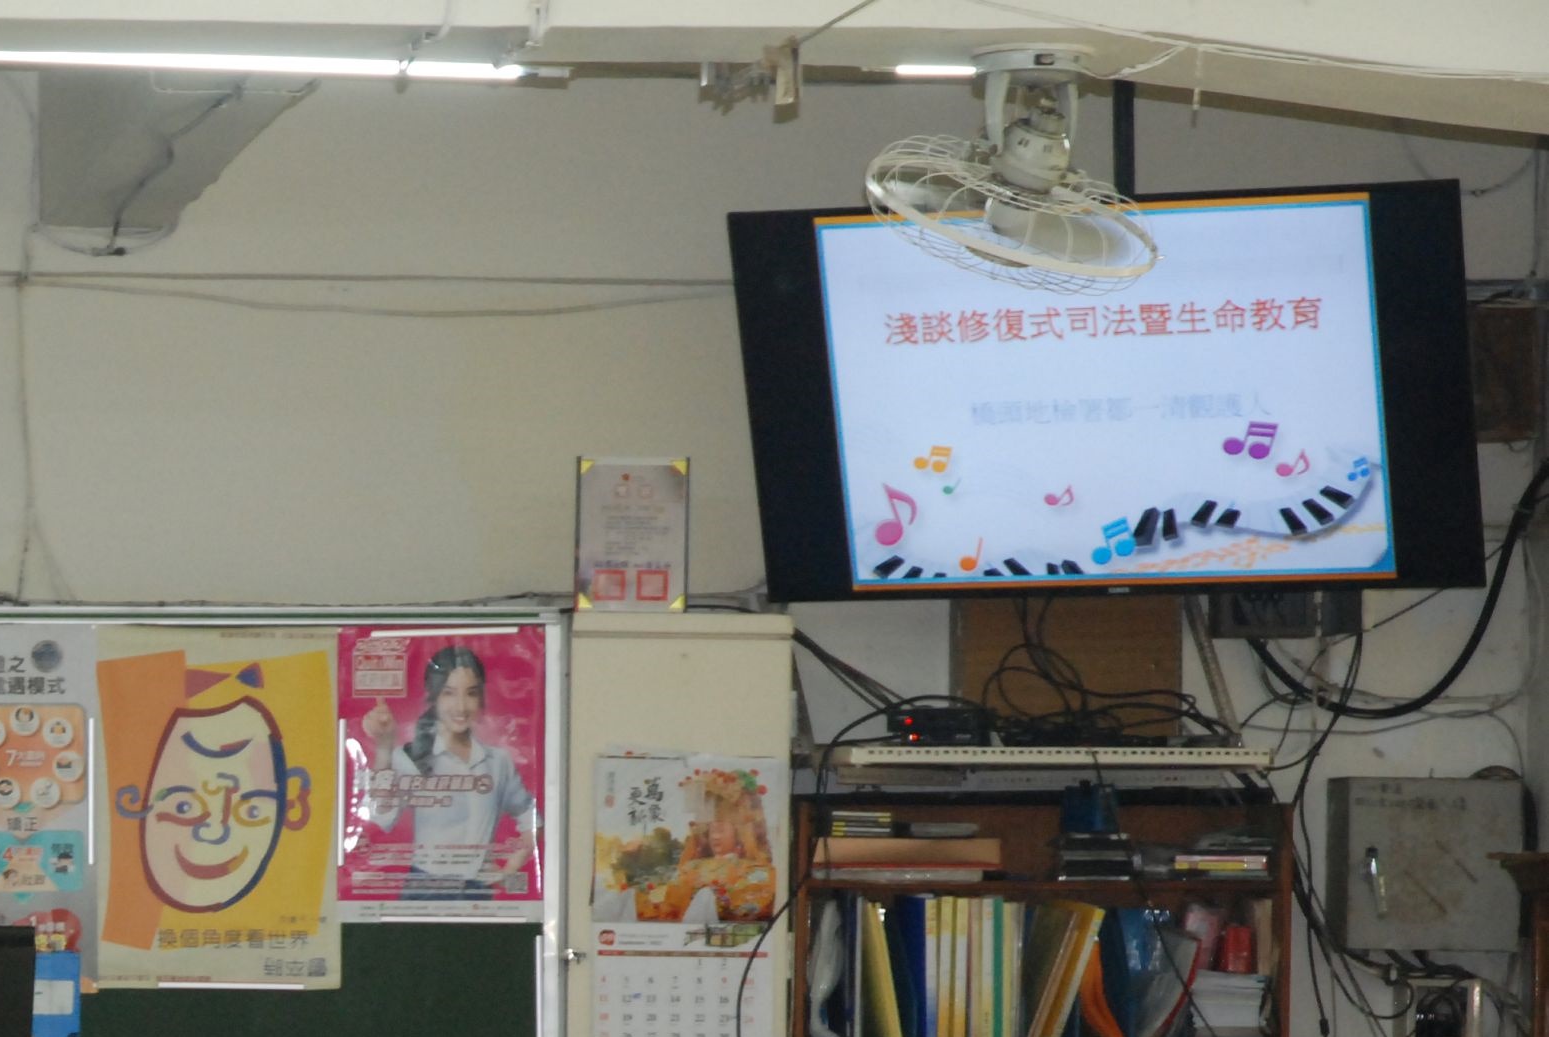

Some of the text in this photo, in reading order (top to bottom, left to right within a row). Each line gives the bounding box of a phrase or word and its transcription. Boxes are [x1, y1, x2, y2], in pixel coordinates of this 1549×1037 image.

[885, 297, 1322, 345] 淺談修復式司法暨生命教育
[157, 929, 308, 950] 換個角度看世界
